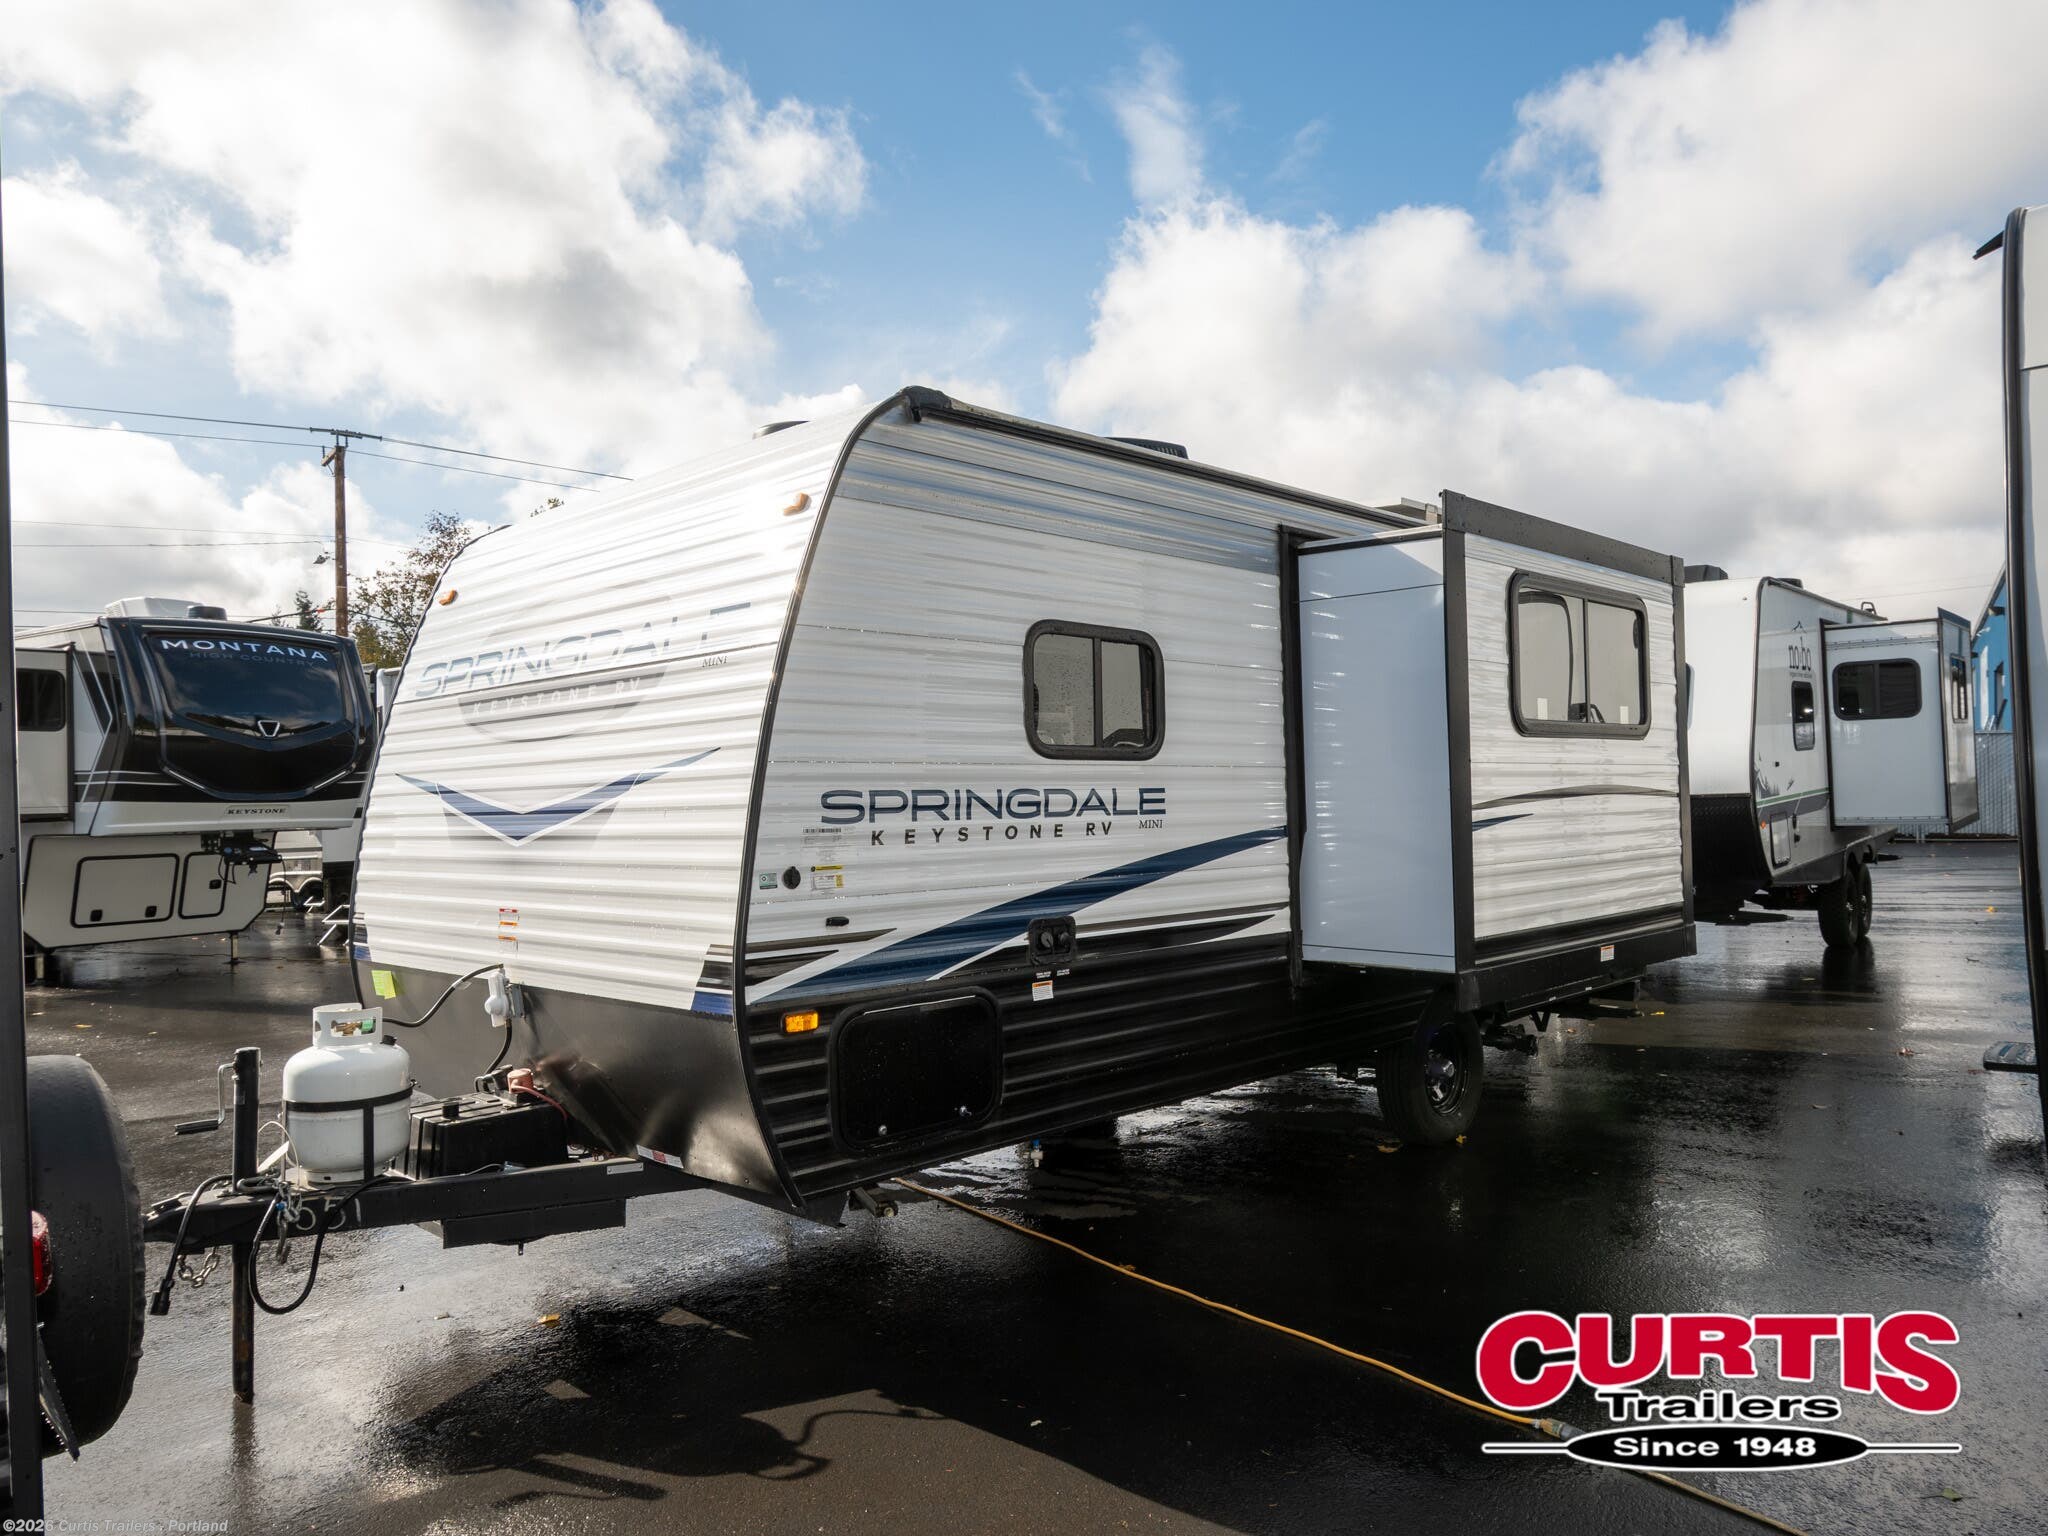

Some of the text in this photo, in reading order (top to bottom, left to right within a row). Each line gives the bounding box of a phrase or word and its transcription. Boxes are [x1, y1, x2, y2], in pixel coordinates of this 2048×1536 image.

[161, 639, 328, 662] MONTANA
[240, 654, 315, 667] COUNTRY
[702, 655, 728, 668] MINI
[473, 677, 641, 717] KEYSTONE RV
[820, 787, 1166, 824] SPRINGDALE
[871, 821, 1112, 846] KEYSTONE RV
[1138, 819, 1164, 830] MINI
